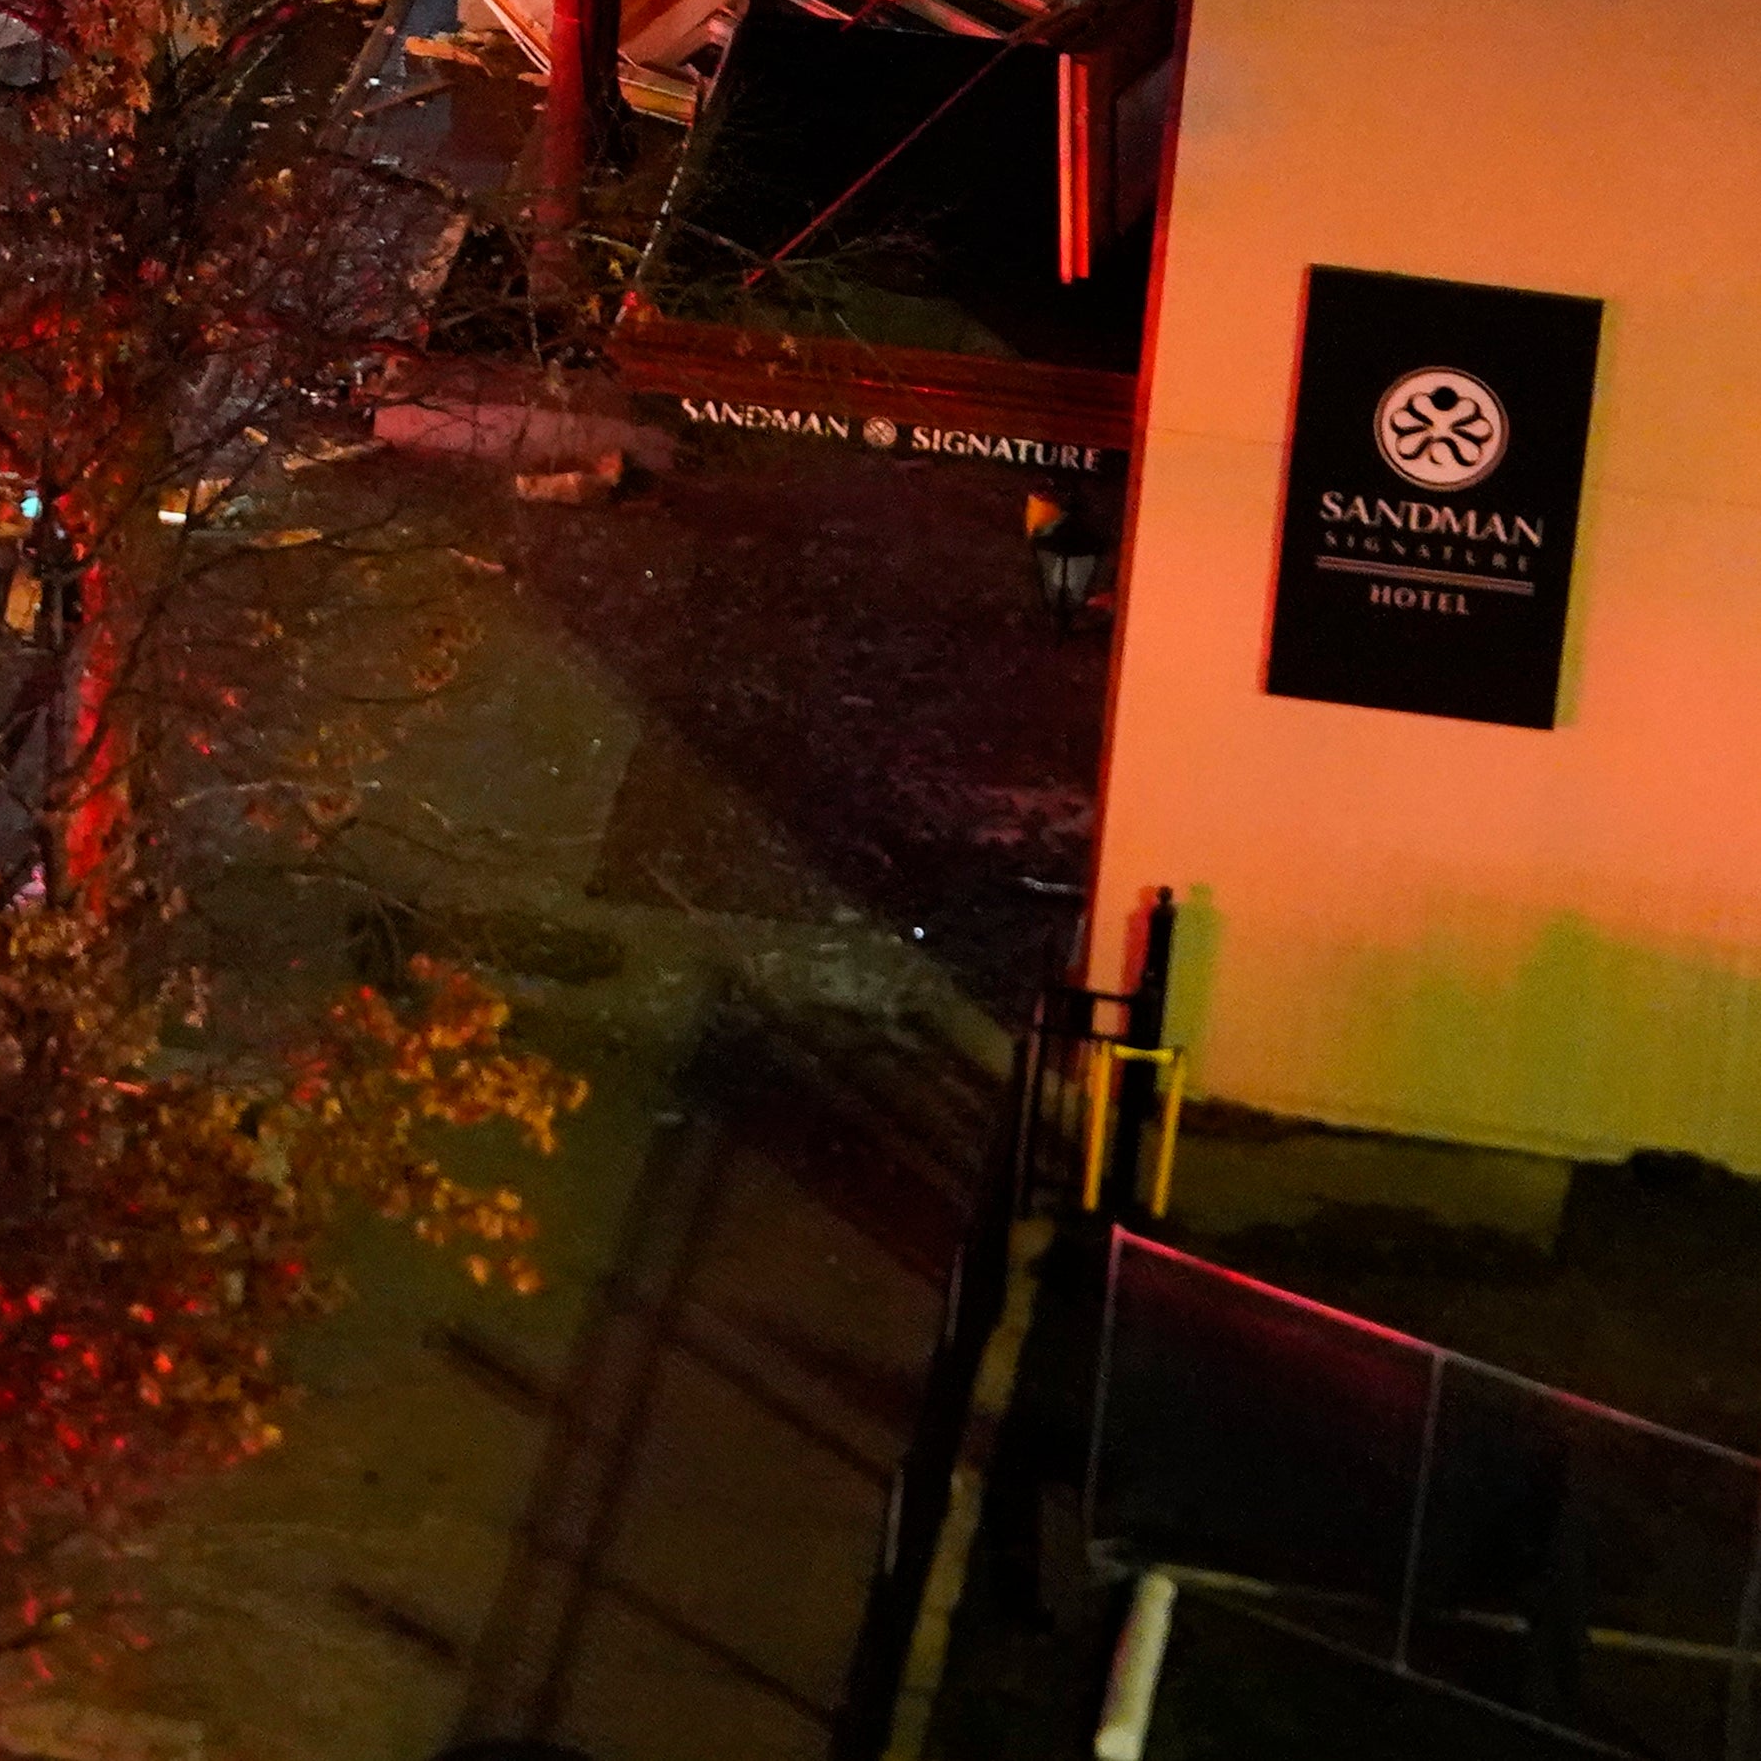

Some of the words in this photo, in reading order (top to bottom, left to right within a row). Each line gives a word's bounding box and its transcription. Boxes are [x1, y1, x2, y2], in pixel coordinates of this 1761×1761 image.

[681, 397, 850, 439] SANDMAN
[911, 425, 1103, 472] SIGNATURE
[1320, 490, 1545, 548] SANDMAN
[1324, 530, 1531, 573] SIGNATURE
[1370, 584, 1470, 616] HOTEL
